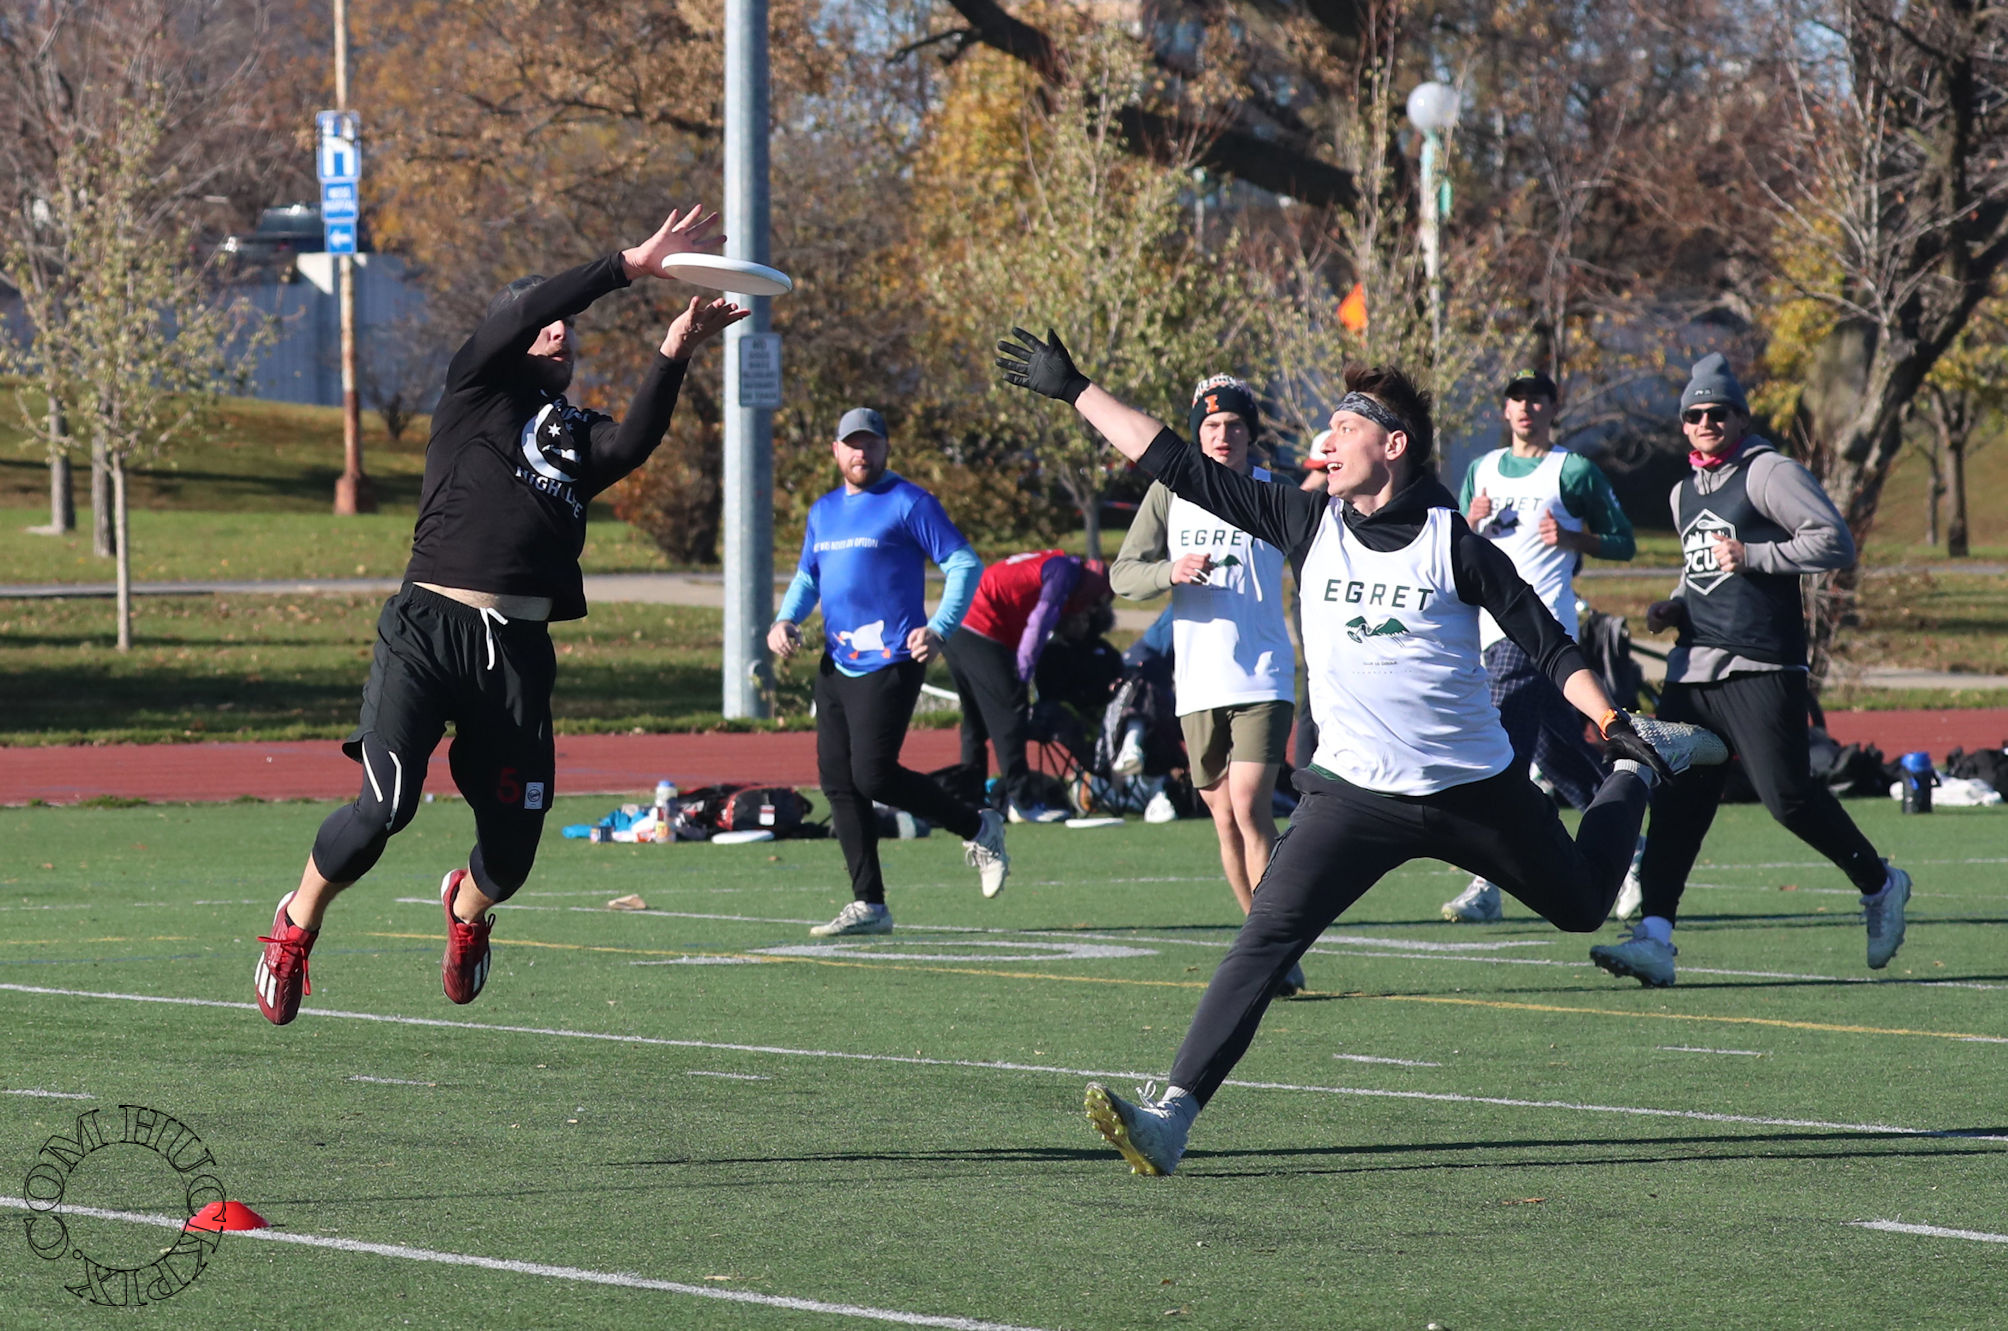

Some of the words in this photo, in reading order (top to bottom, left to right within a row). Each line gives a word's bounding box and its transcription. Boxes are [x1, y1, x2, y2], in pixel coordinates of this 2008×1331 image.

[1205, 394, 1220, 414] I
[1323, 578, 1434, 611] EGRET
[498, 767, 520, 804] 5
